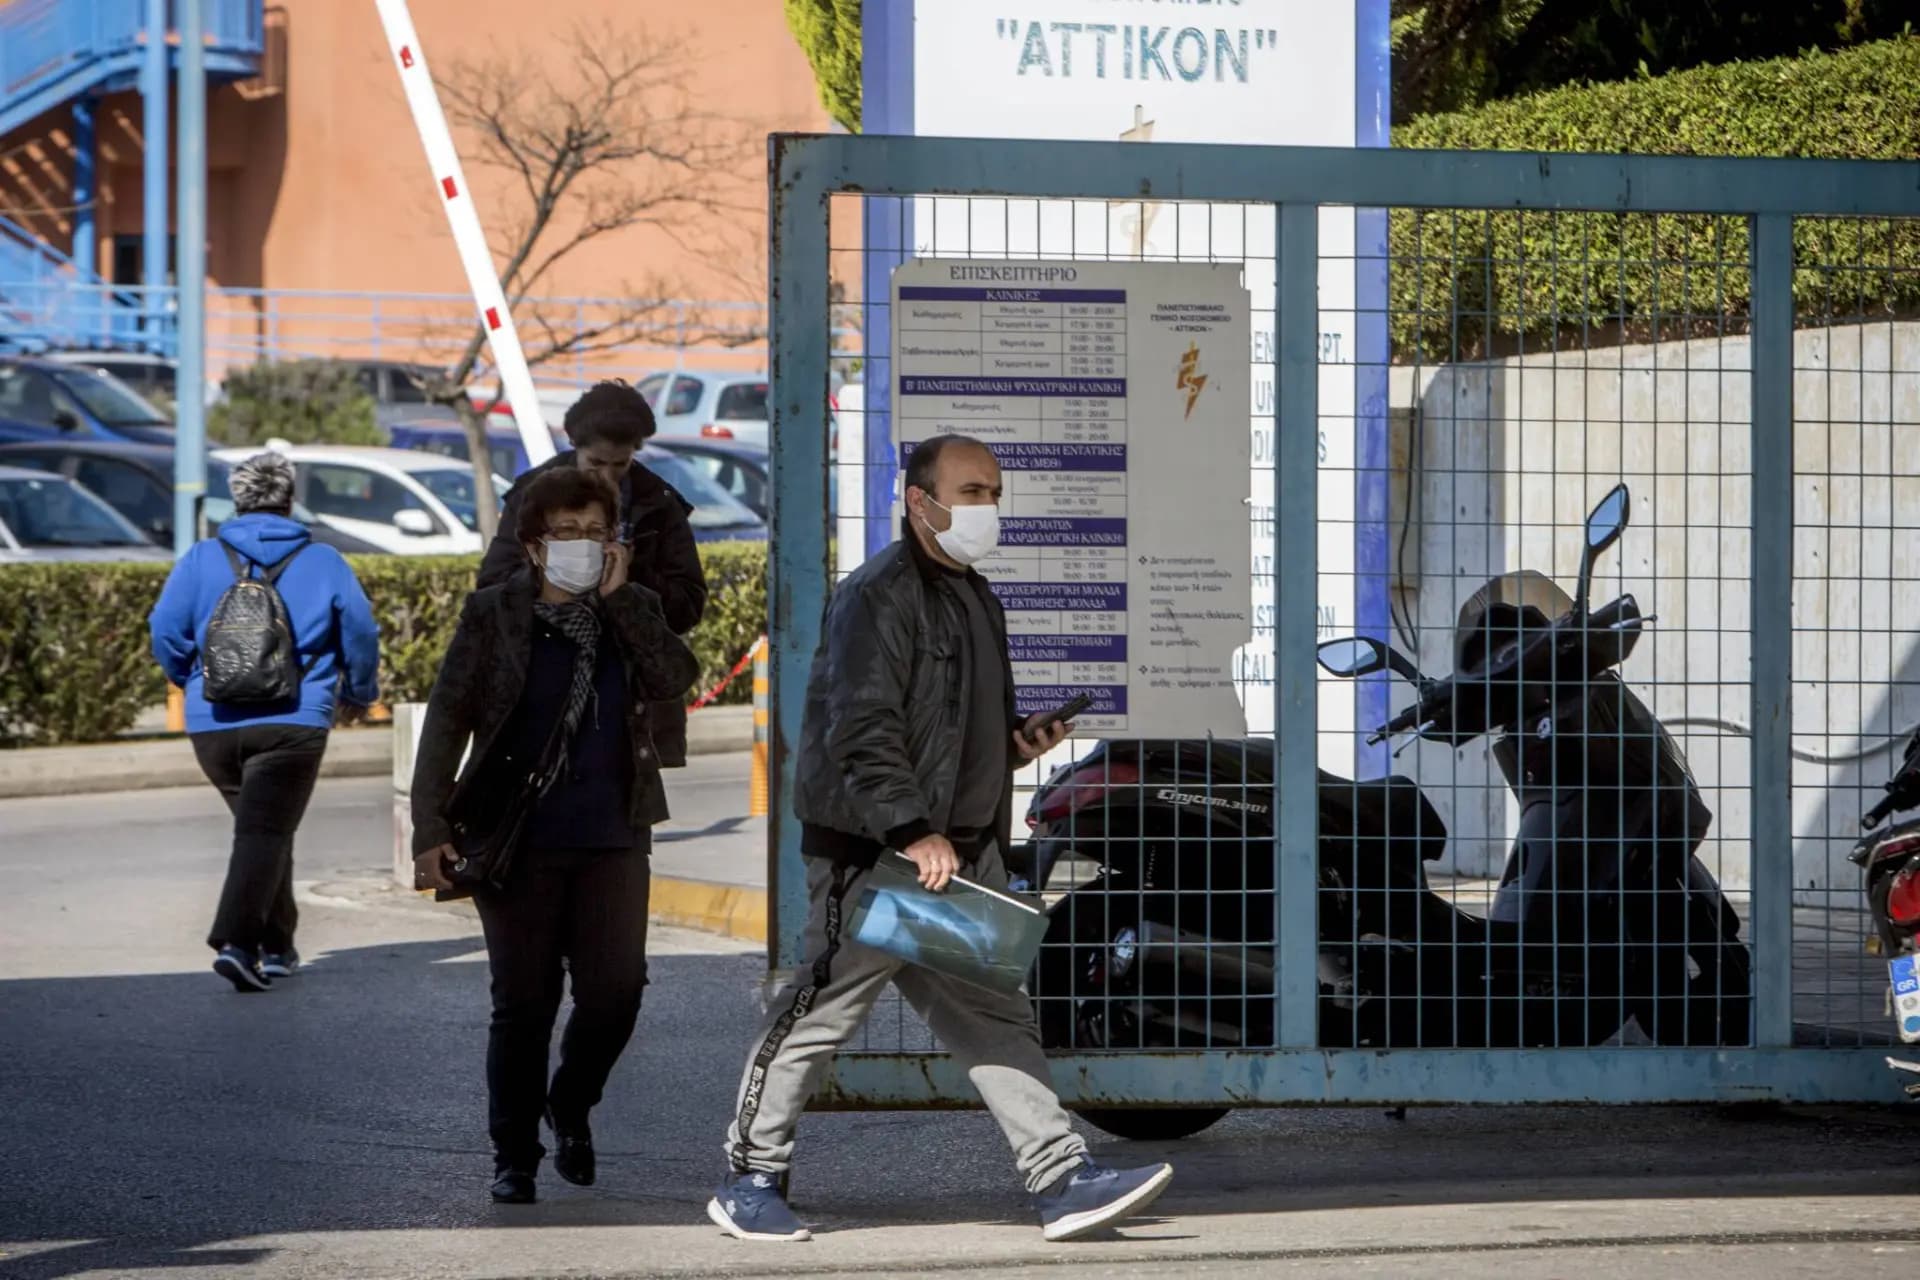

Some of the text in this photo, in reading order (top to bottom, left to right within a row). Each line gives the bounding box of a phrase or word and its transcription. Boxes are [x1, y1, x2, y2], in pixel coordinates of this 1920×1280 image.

[996, 18, 1277, 83] "ΑΤΤΙΚΟΝ"
[950, 266, 1077, 282] ΕΠΙΣΚΕΠΤΗΡΙΟ
[986, 290, 1041, 301] ΚΛΙΝΙΚΕΣ
[1014, 381, 1077, 392] ΨΥΧΙΑΤΡΙΚΗ
[1079, 382, 1122, 393] ΚΛΙΝΙΚΗ
[1255, 380, 1275, 414] UN
[1016, 445, 1060, 456] ΚΛΙΝΙΚΗ
[1063, 446, 1124, 456] ΕΝΤΑΤΙΚΗΣ
[991, 585, 1080, 596] ΑΡΔΙΟΧΕΙΡΟΥΡΓΙΚΗ
[1896, 979, 1917, 992] GR
